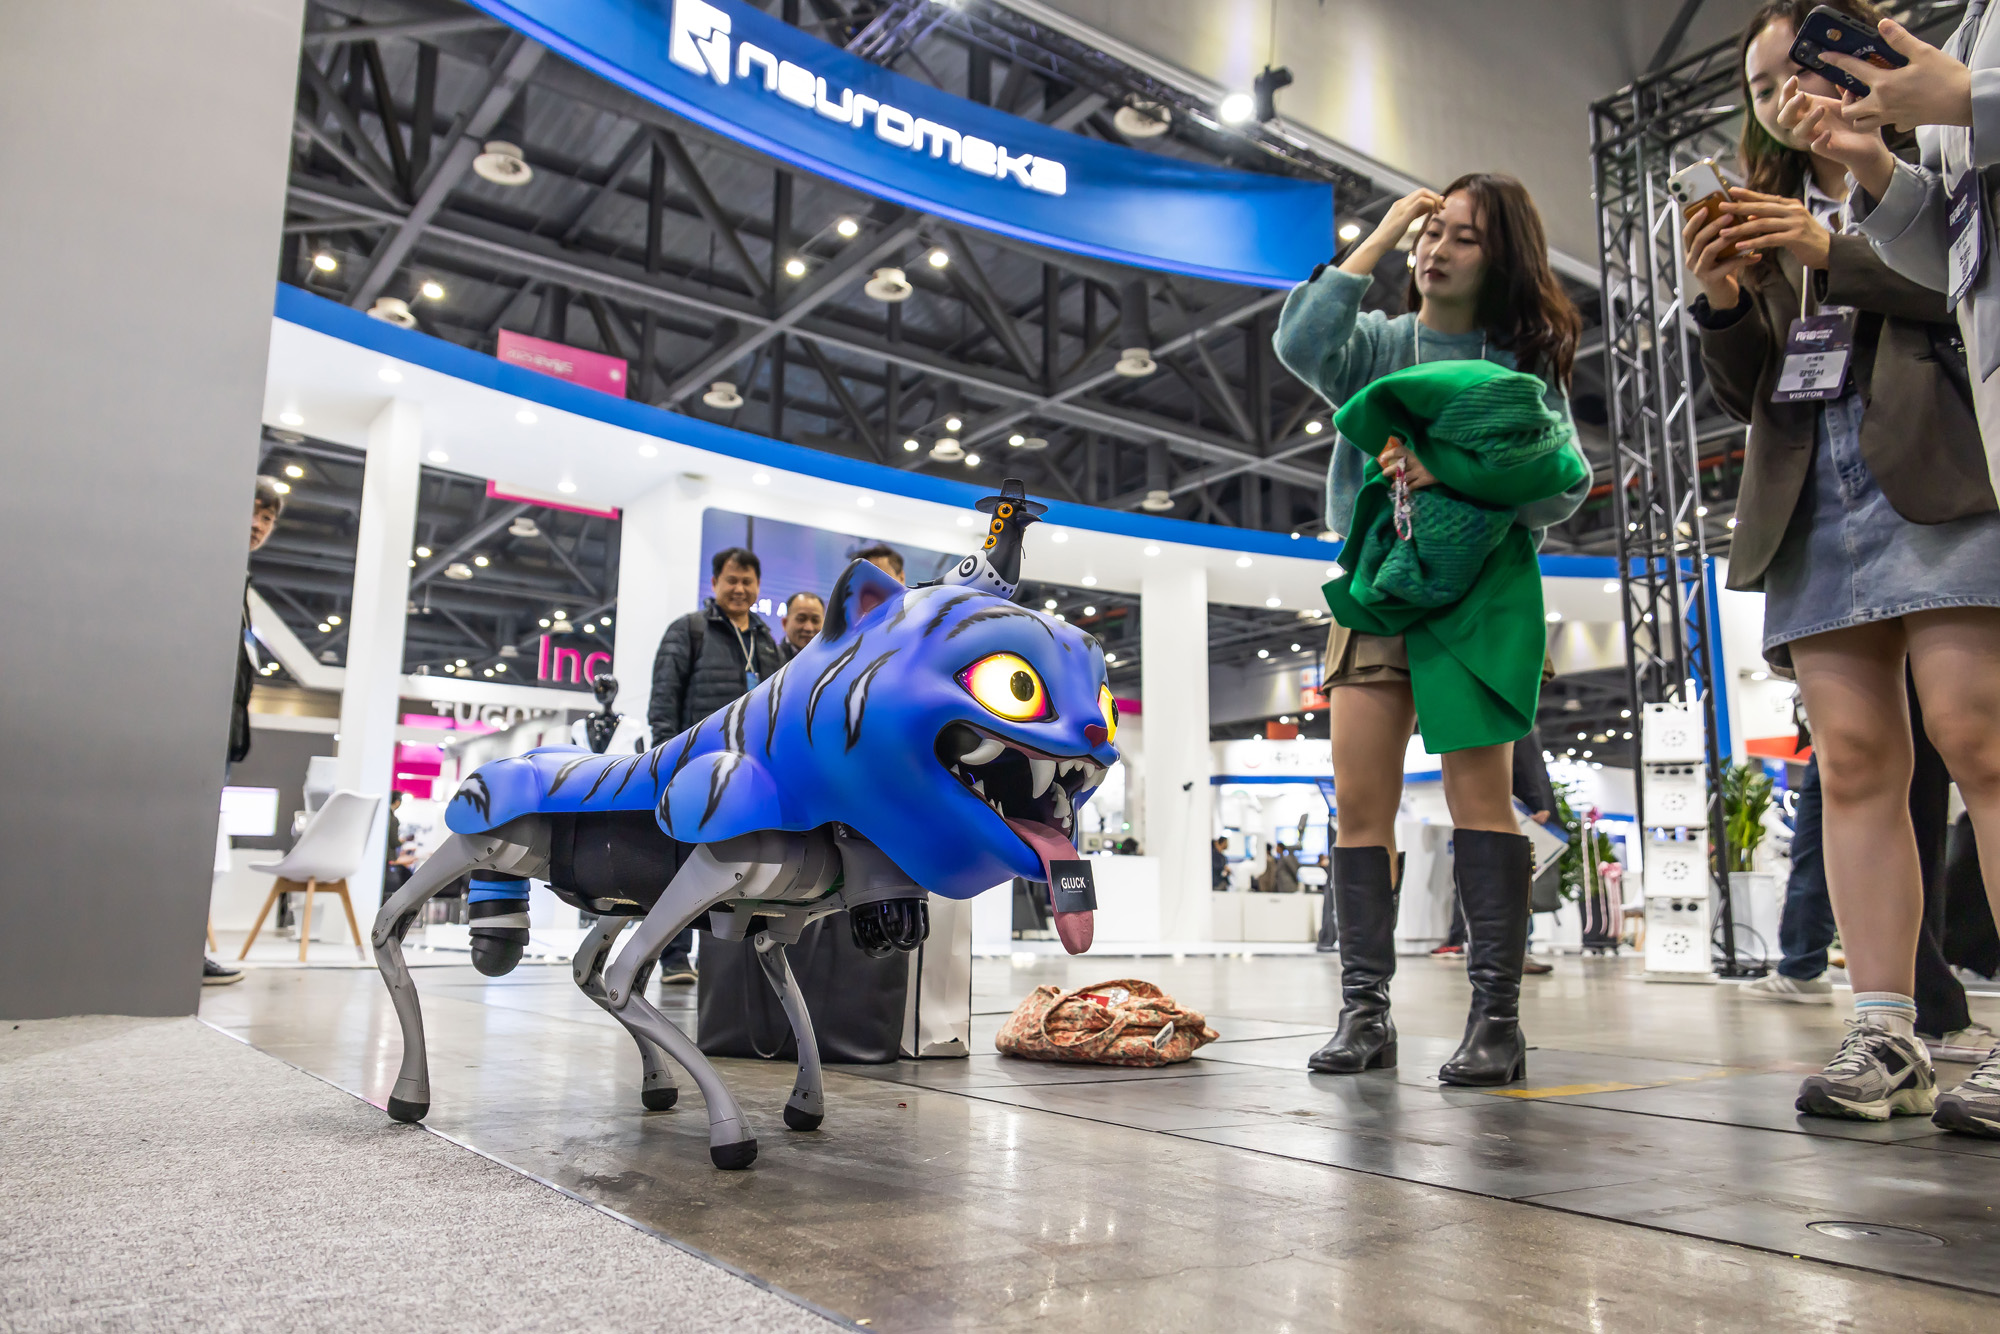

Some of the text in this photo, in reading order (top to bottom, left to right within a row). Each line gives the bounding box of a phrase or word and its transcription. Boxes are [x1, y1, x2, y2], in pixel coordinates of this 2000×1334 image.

[736, 41, 1067, 195] neuromeka
[1789, 390, 1825, 400] VISITOR
[1061, 877, 1086, 889] GLUCK
